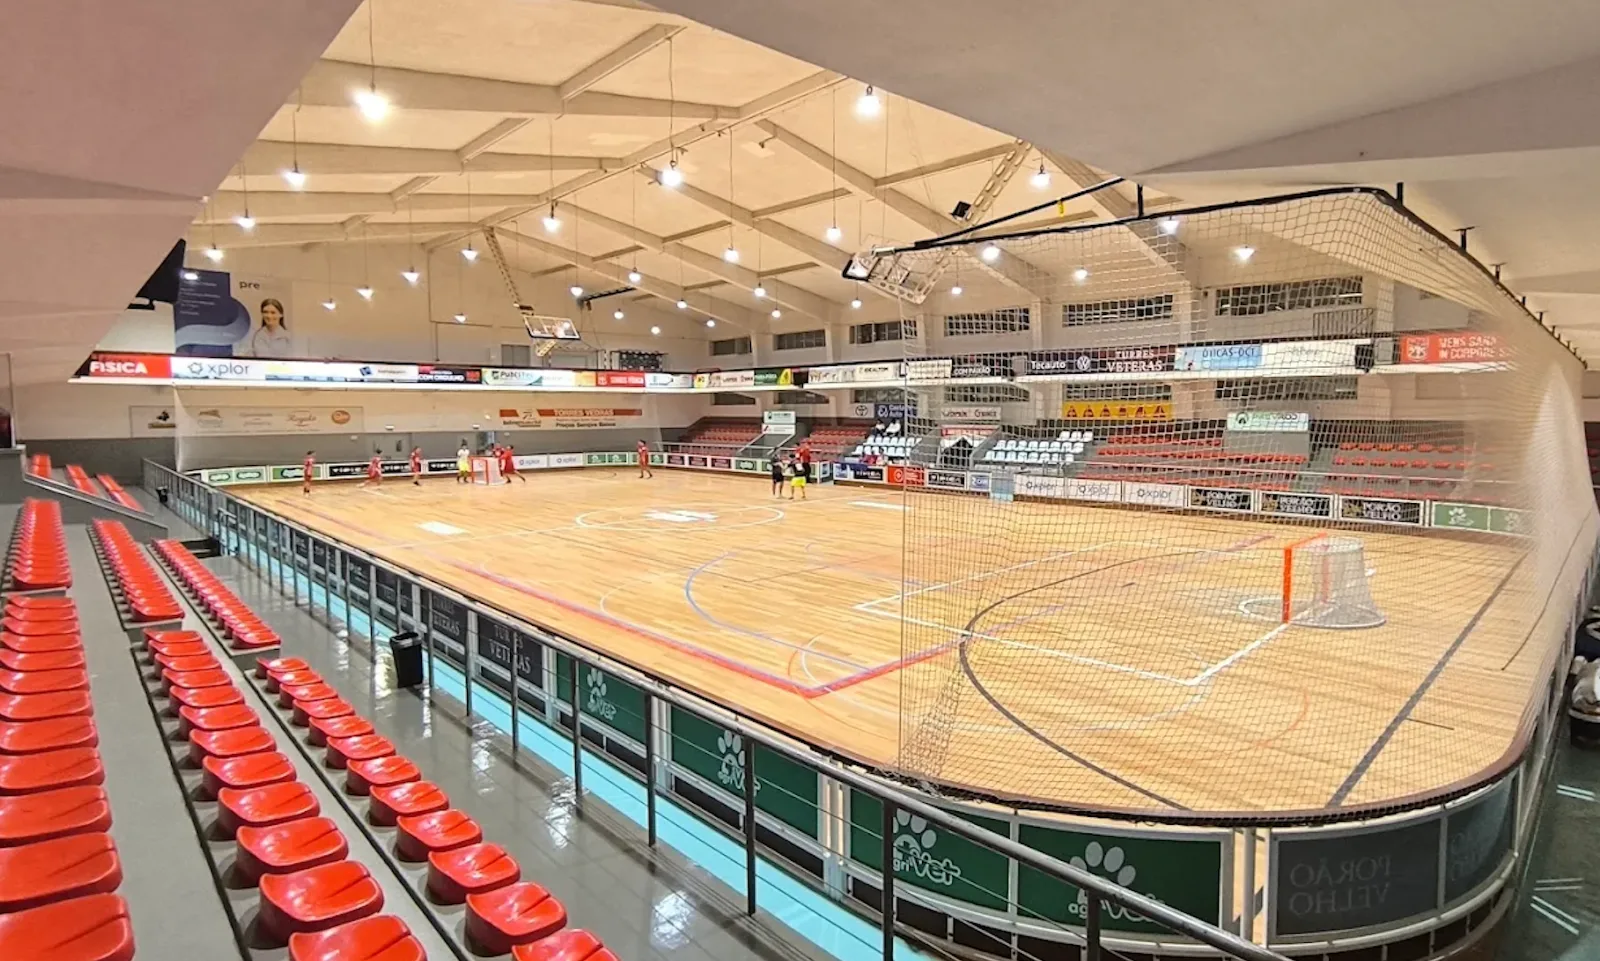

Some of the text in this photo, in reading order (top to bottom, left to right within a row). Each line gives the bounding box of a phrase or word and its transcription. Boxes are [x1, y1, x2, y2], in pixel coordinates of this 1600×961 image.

[239, 280, 260, 290] pre
[1031, 360, 1066, 370] Tecauto
[1107, 360, 1163, 372] VETERAS
